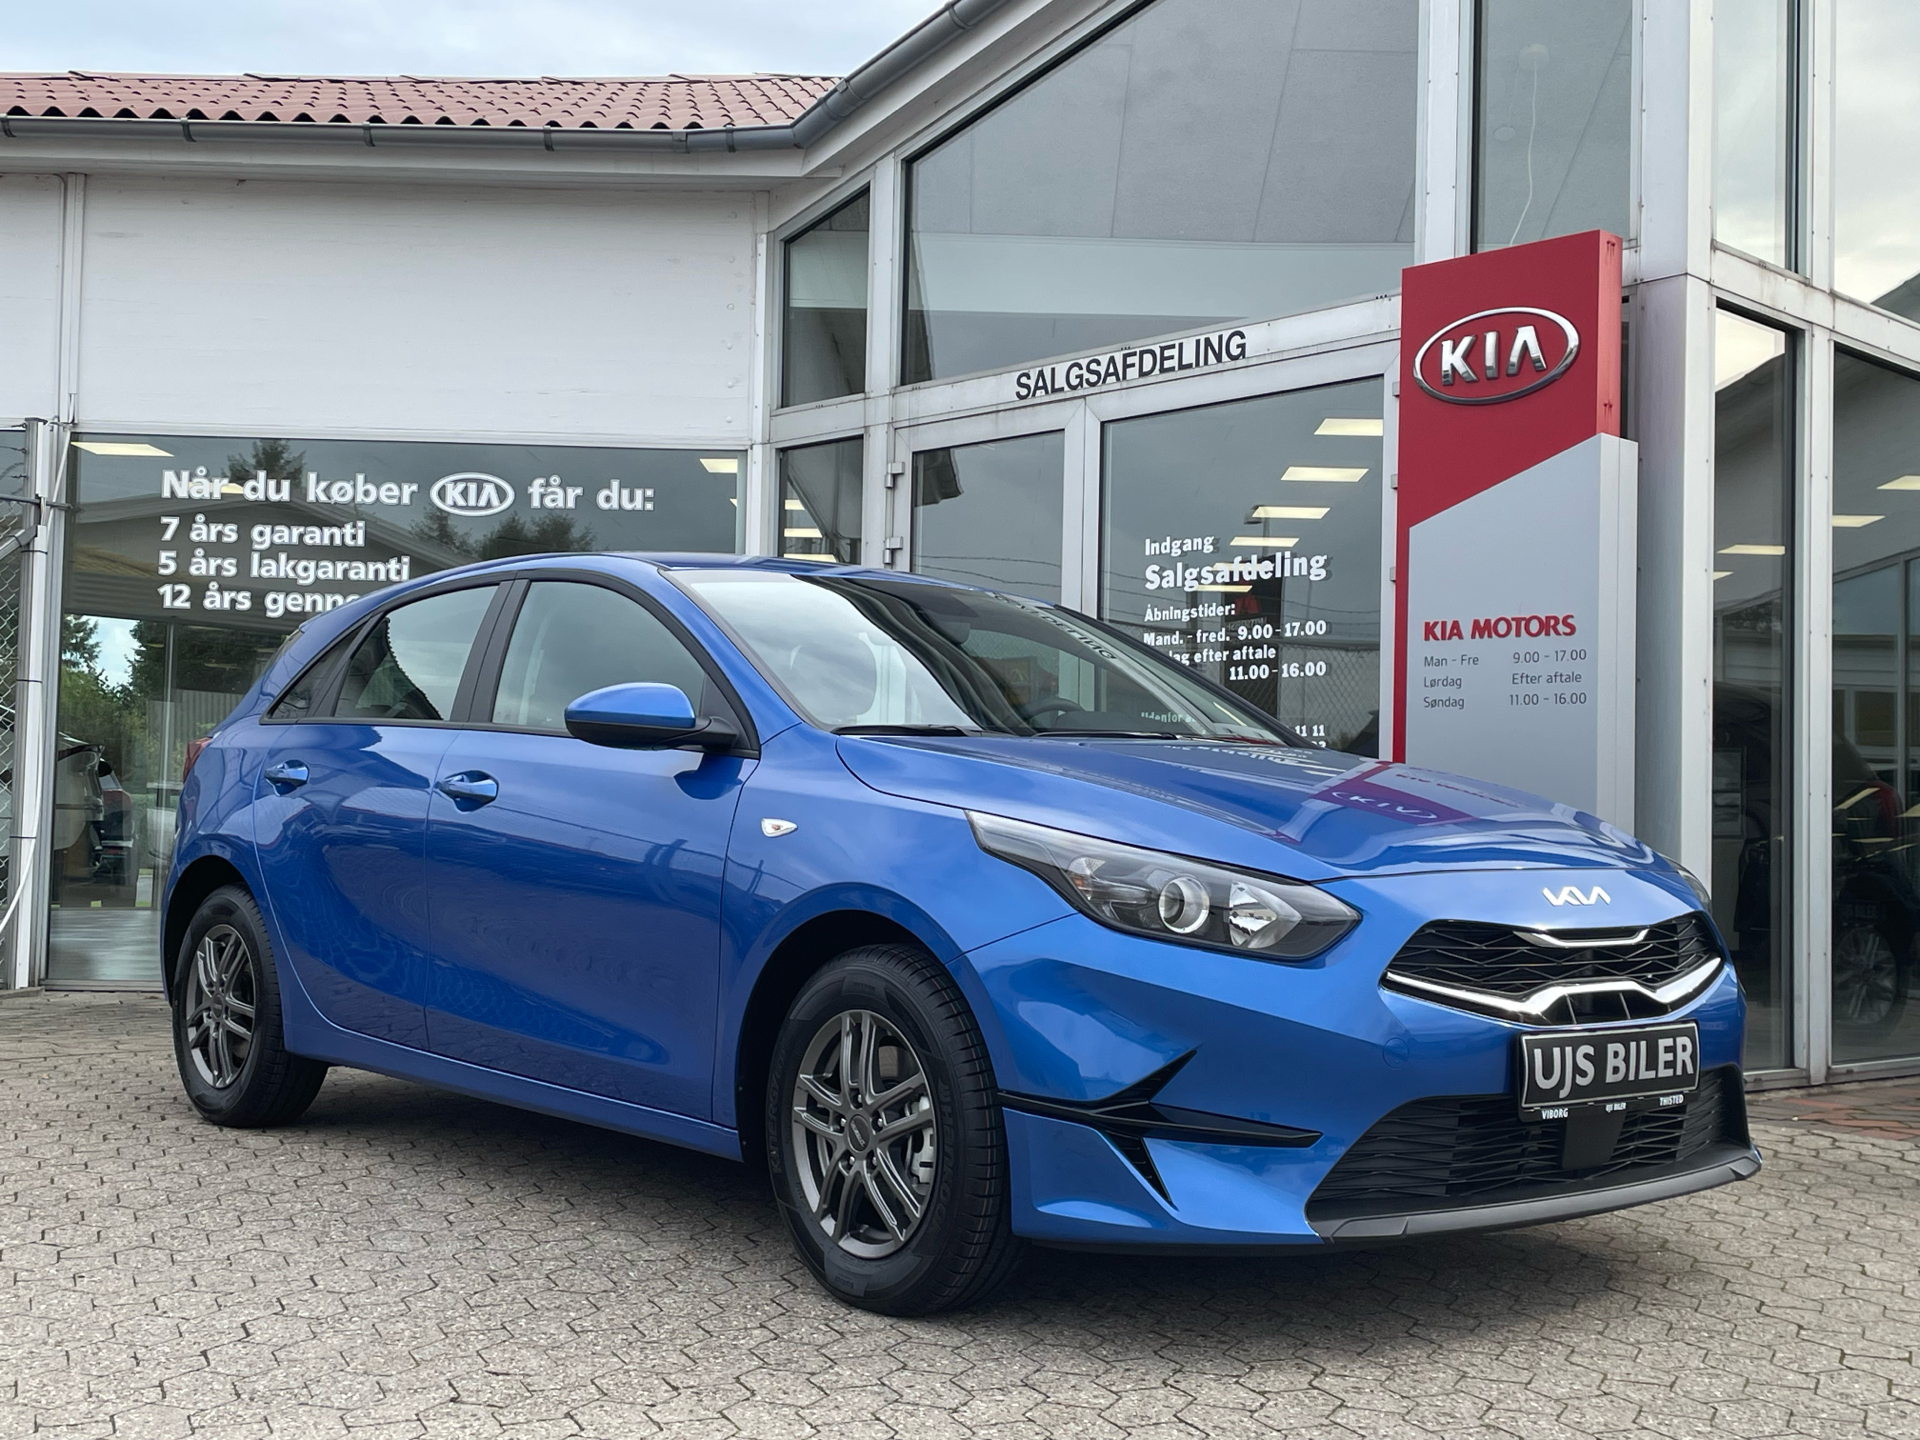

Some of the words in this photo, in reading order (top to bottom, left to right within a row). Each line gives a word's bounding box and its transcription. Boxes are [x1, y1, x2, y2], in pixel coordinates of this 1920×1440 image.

[1015, 330, 1247, 400] SALGSAFDELING
[1441, 325, 1547, 387] KIA
[161, 466, 229, 500] Når
[242, 470, 291, 502] du
[307, 471, 418, 505] køber
[445, 482, 500, 507] KIA
[527, 474, 584, 509] får
[596, 479, 655, 511] du:
[160, 516, 180, 542] 7
[189, 513, 238, 543] års
[251, 520, 366, 550] garanti
[1145, 535, 1215, 557] Indgang
[158, 550, 177, 575] 5
[188, 548, 238, 577] års
[250, 552, 411, 586] lakgaranti
[1144, 551, 1328, 592] Salgsafdeling
[157, 584, 191, 610] 12
[203, 581, 251, 611] års
[1144, 603, 1236, 622] Åbningstider:
[1143, 631, 1184, 647] Mand.
[1196, 627, 1230, 644] fred.
[1423, 620, 1464, 641] KIA
[1471, 614, 1577, 640] MOTORS
[1194, 648, 1229, 664] efter
[1232, 644, 1276, 661] aftale
[1424, 655, 1448, 667] Man
[1460, 654, 1479, 666] Fre
[1512, 651, 1540, 664] 9.00
[1554, 648, 1587, 662] 17.00
[1424, 676, 1462, 690] Lørdag
[1511, 672, 1543, 685] Efter
[1546, 671, 1582, 684] aftale
[1423, 696, 1465, 710] Søndag
[1509, 693, 1539, 706] 11.00
[1553, 692, 1587, 705] 16.00
[1534, 1044, 1596, 1099] UJS
[1605, 1035, 1695, 1084] BILER
[1541, 1108, 1569, 1120] VIBORG
[1659, 1094, 1684, 1106] THISTED
